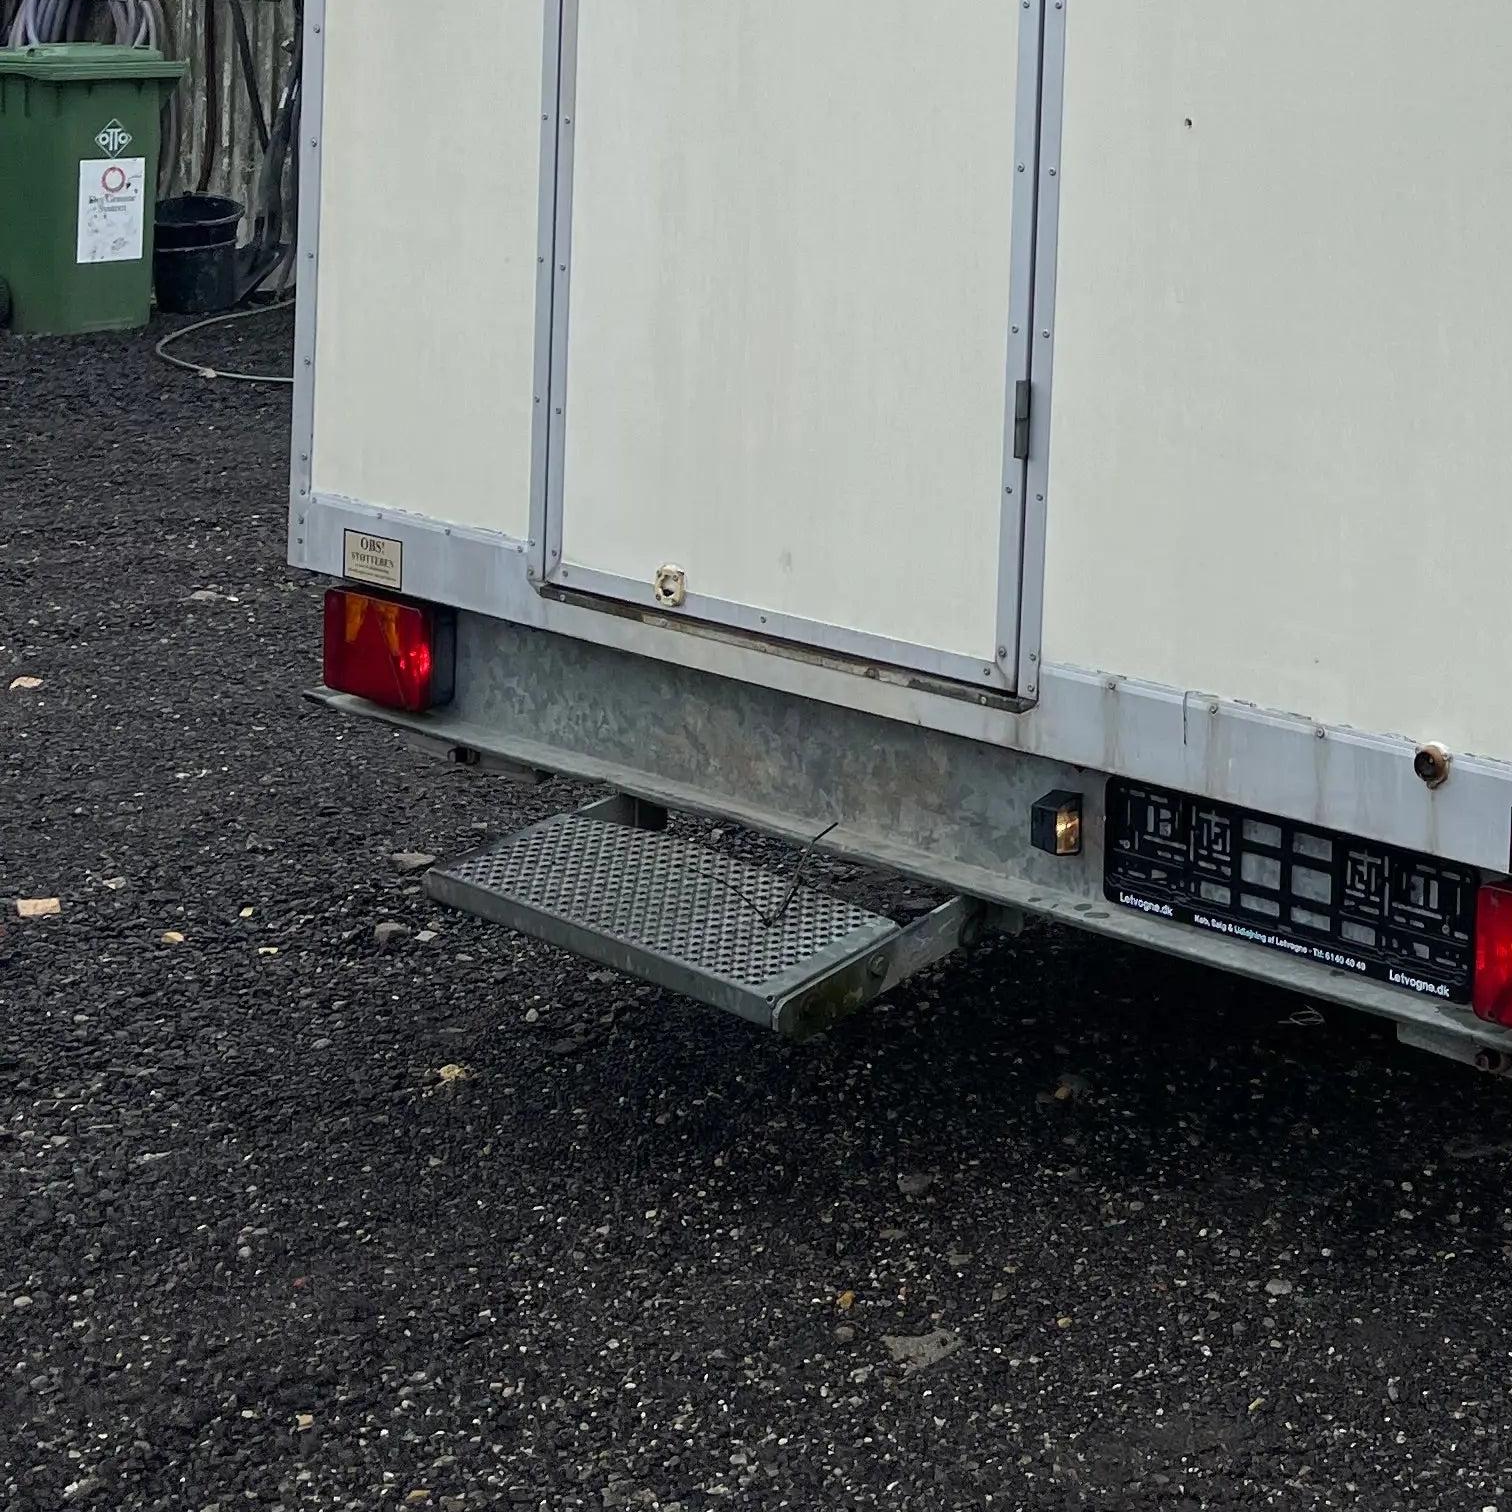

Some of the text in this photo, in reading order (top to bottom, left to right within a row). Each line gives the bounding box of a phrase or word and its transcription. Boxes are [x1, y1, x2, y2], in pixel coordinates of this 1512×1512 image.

[99, 128, 129, 151] OTTO
[360, 537, 385, 555] OBS!
[1119, 891, 1174, 917] Letvogne.dk
[1211, 918, 1228, 932] Salg
[1228, 923, 1234, 933] &
[1389, 968, 1450, 998] Letvogne.dk
